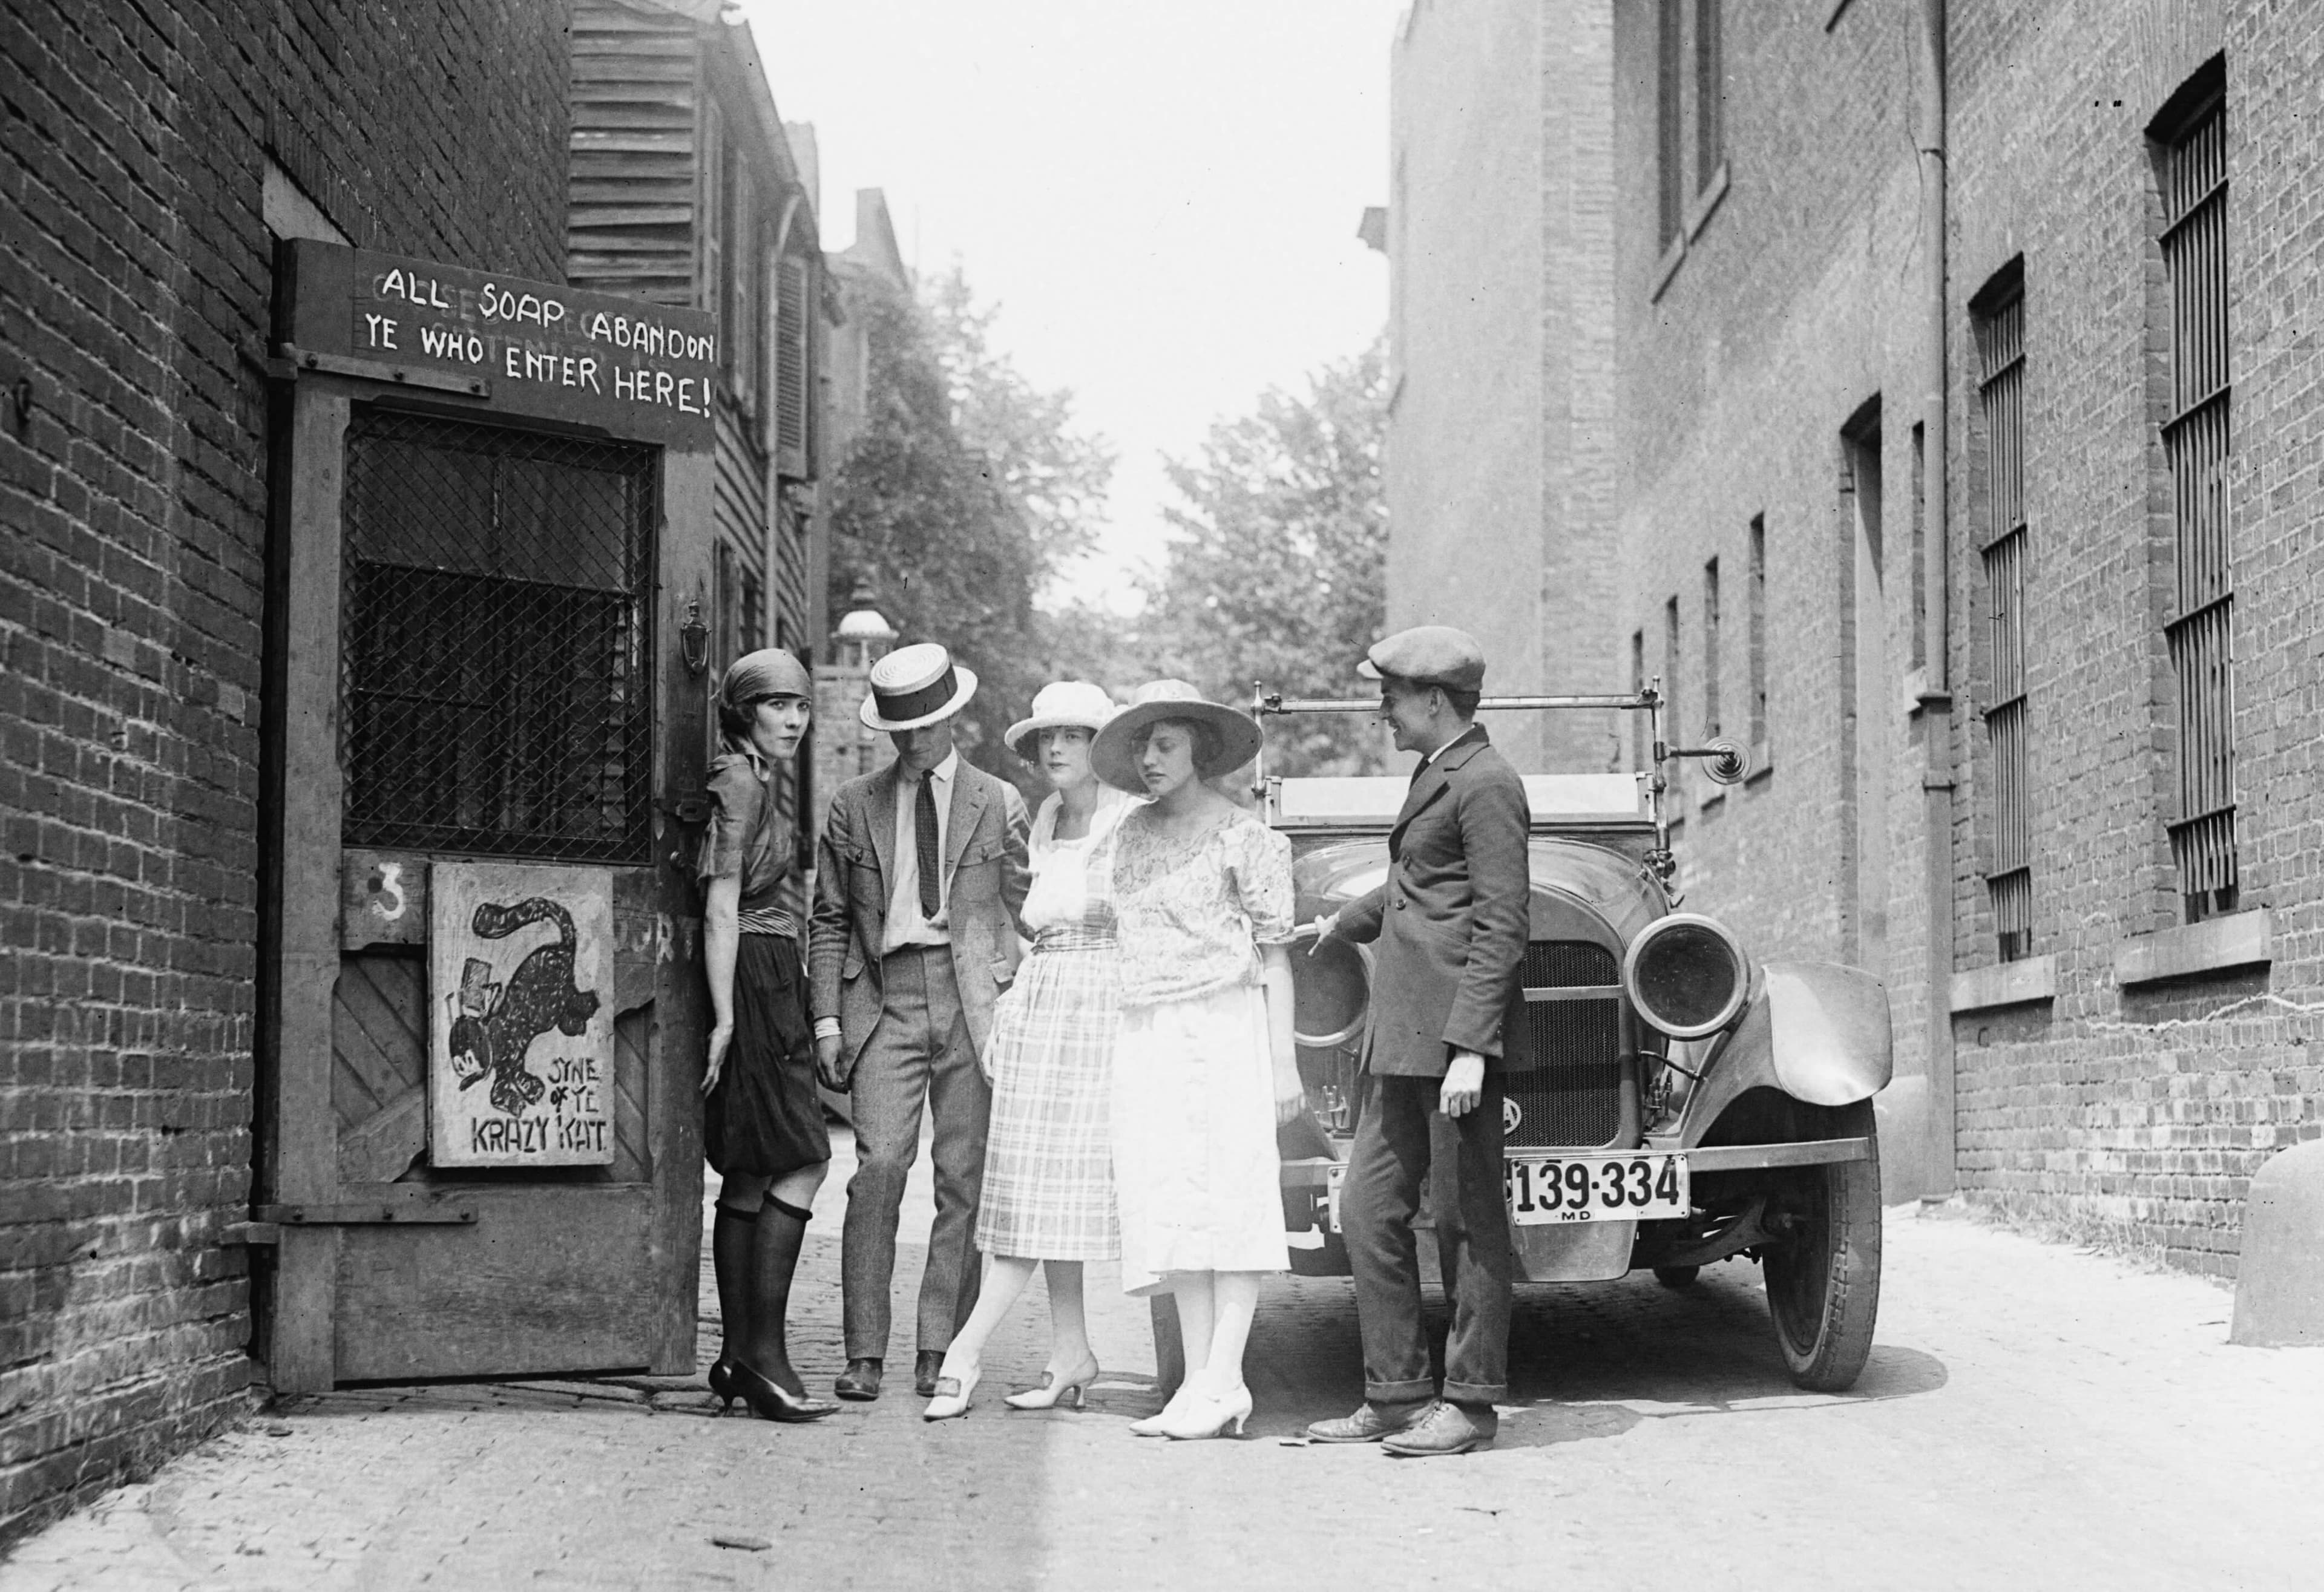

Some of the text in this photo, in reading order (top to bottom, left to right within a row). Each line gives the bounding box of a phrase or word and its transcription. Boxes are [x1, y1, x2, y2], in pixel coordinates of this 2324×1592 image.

[382, 269, 450, 309] ALL
[479, 283, 565, 328] SOAP
[591, 312, 714, 363] ABANDON
[366, 313, 398, 350] YE
[421, 327, 484, 364] WHO
[506, 347, 600, 395] ENTER
[615, 365, 711, 418] HERE!
[571, 1086, 599, 1113] YE
[471, 1116, 550, 1153] KRAZY
[1561, 1211, 1590, 1220] MD
